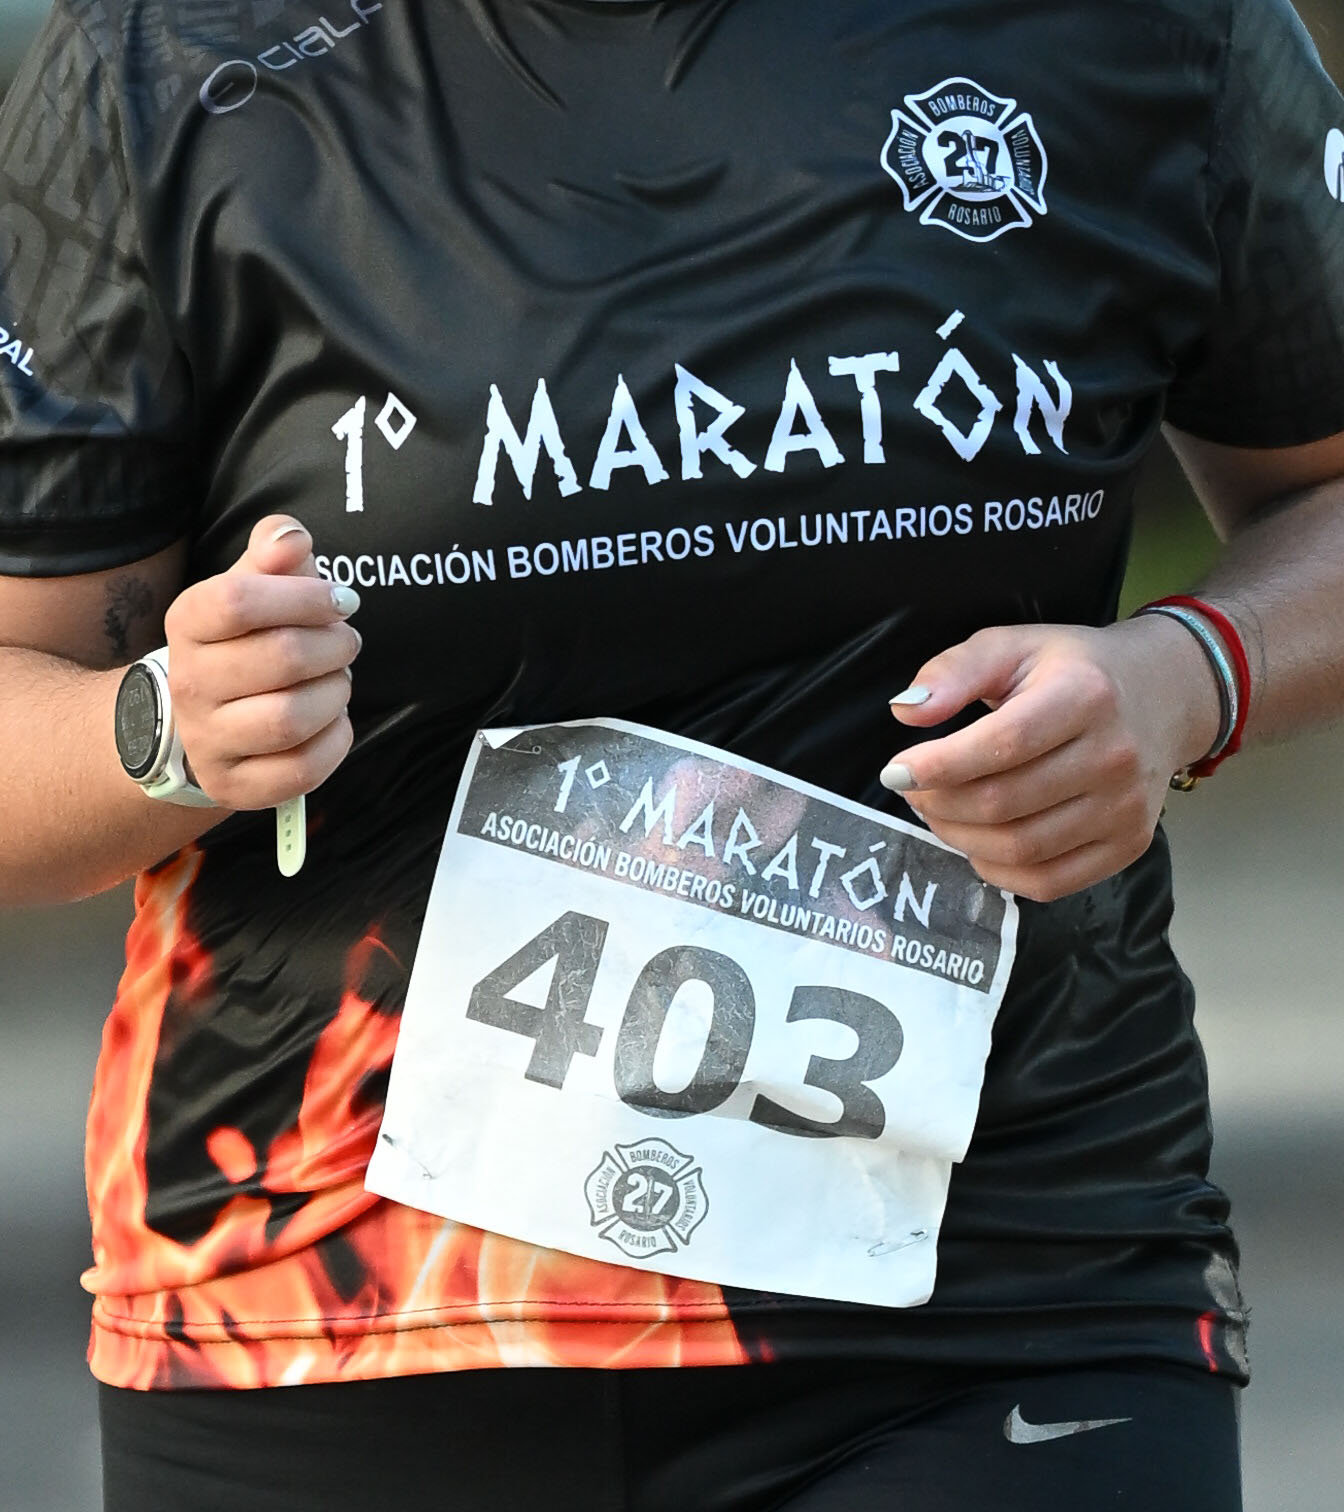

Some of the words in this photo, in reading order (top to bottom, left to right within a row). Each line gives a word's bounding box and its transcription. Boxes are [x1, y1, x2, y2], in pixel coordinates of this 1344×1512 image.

[928, 94, 996, 117] BOMBEROS
[937, 130, 999, 177] 27
[947, 203, 1002, 226] ROSARIO
[473, 309, 1072, 506] MARATÓN
[315, 544, 497, 587] SOCIACIÓN
[508, 525, 715, 578] BOMBEROS
[727, 503, 973, 553] VOLUNTARIOS
[985, 490, 1103, 532] ROSARIO
[619, 776, 939, 929] MARATÓN
[480, 811, 612, 872] ASOCIACIÓN
[614, 850, 736, 908] BOMBEROS
[739, 888, 886, 954] VOLUNTARIOS
[890, 935, 985, 986] ROSARIO
[465, 910, 905, 1140] 403
[622, 1172, 673, 1215] 27
[629, 1149, 680, 1170] BOMBEROS
